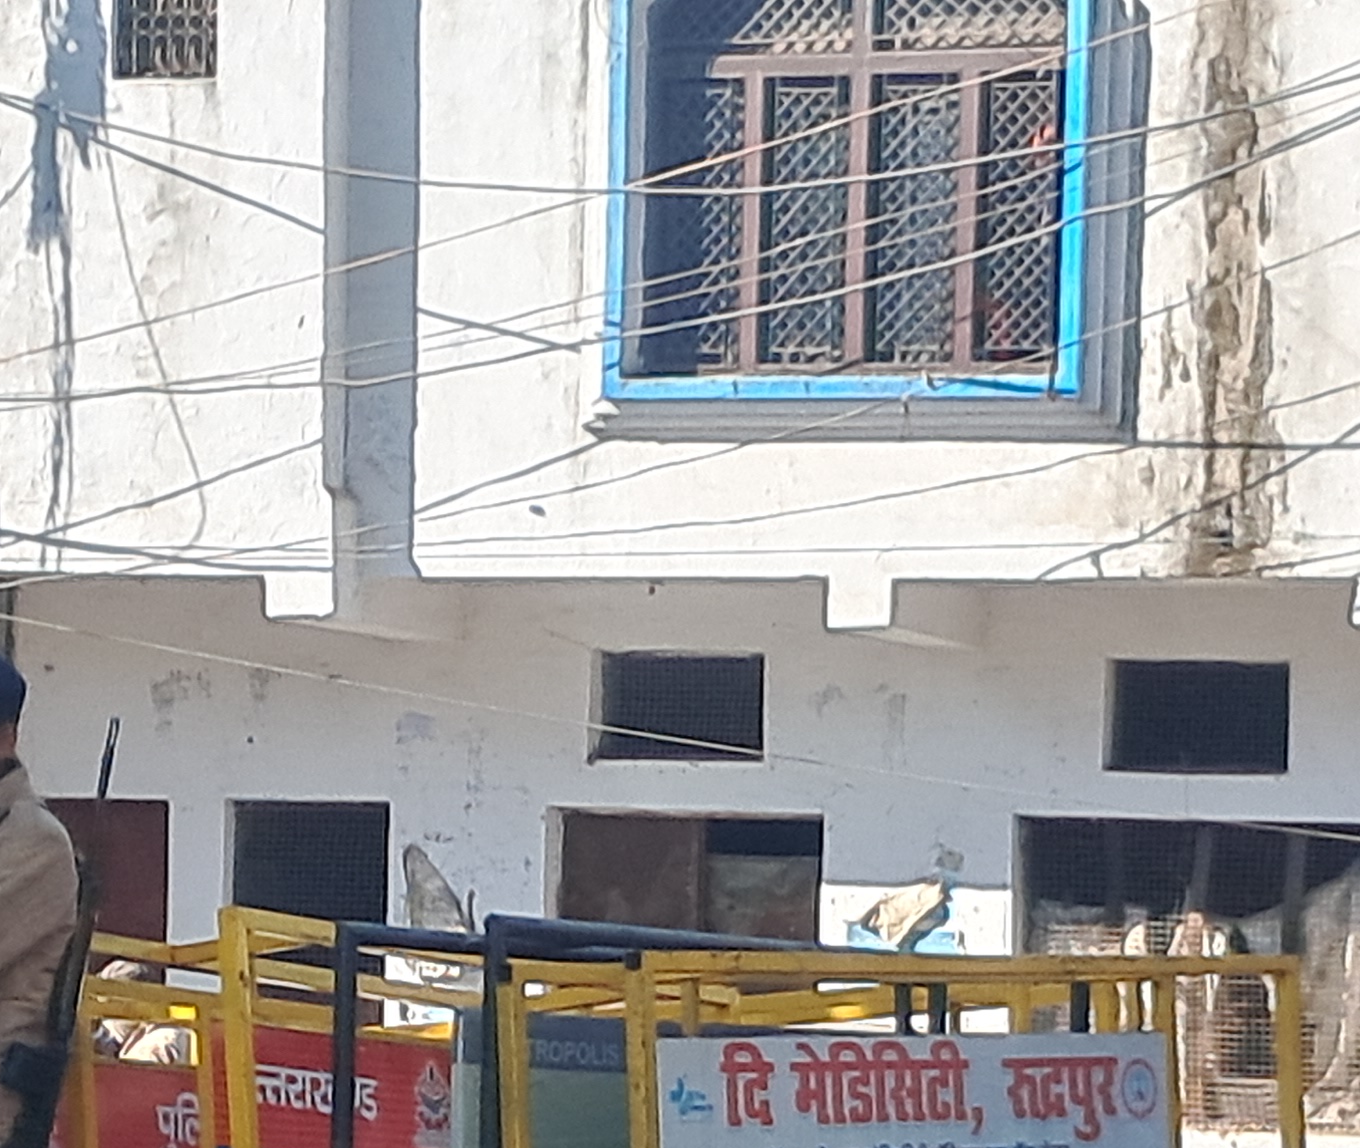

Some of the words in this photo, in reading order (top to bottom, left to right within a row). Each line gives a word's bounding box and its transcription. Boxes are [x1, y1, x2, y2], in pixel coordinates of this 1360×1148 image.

[534, 1038, 620, 1065] ROPOLIS
[720, 1042, 775, 1127] दि
[790, 1040, 985, 1136] मेडिसिटी,
